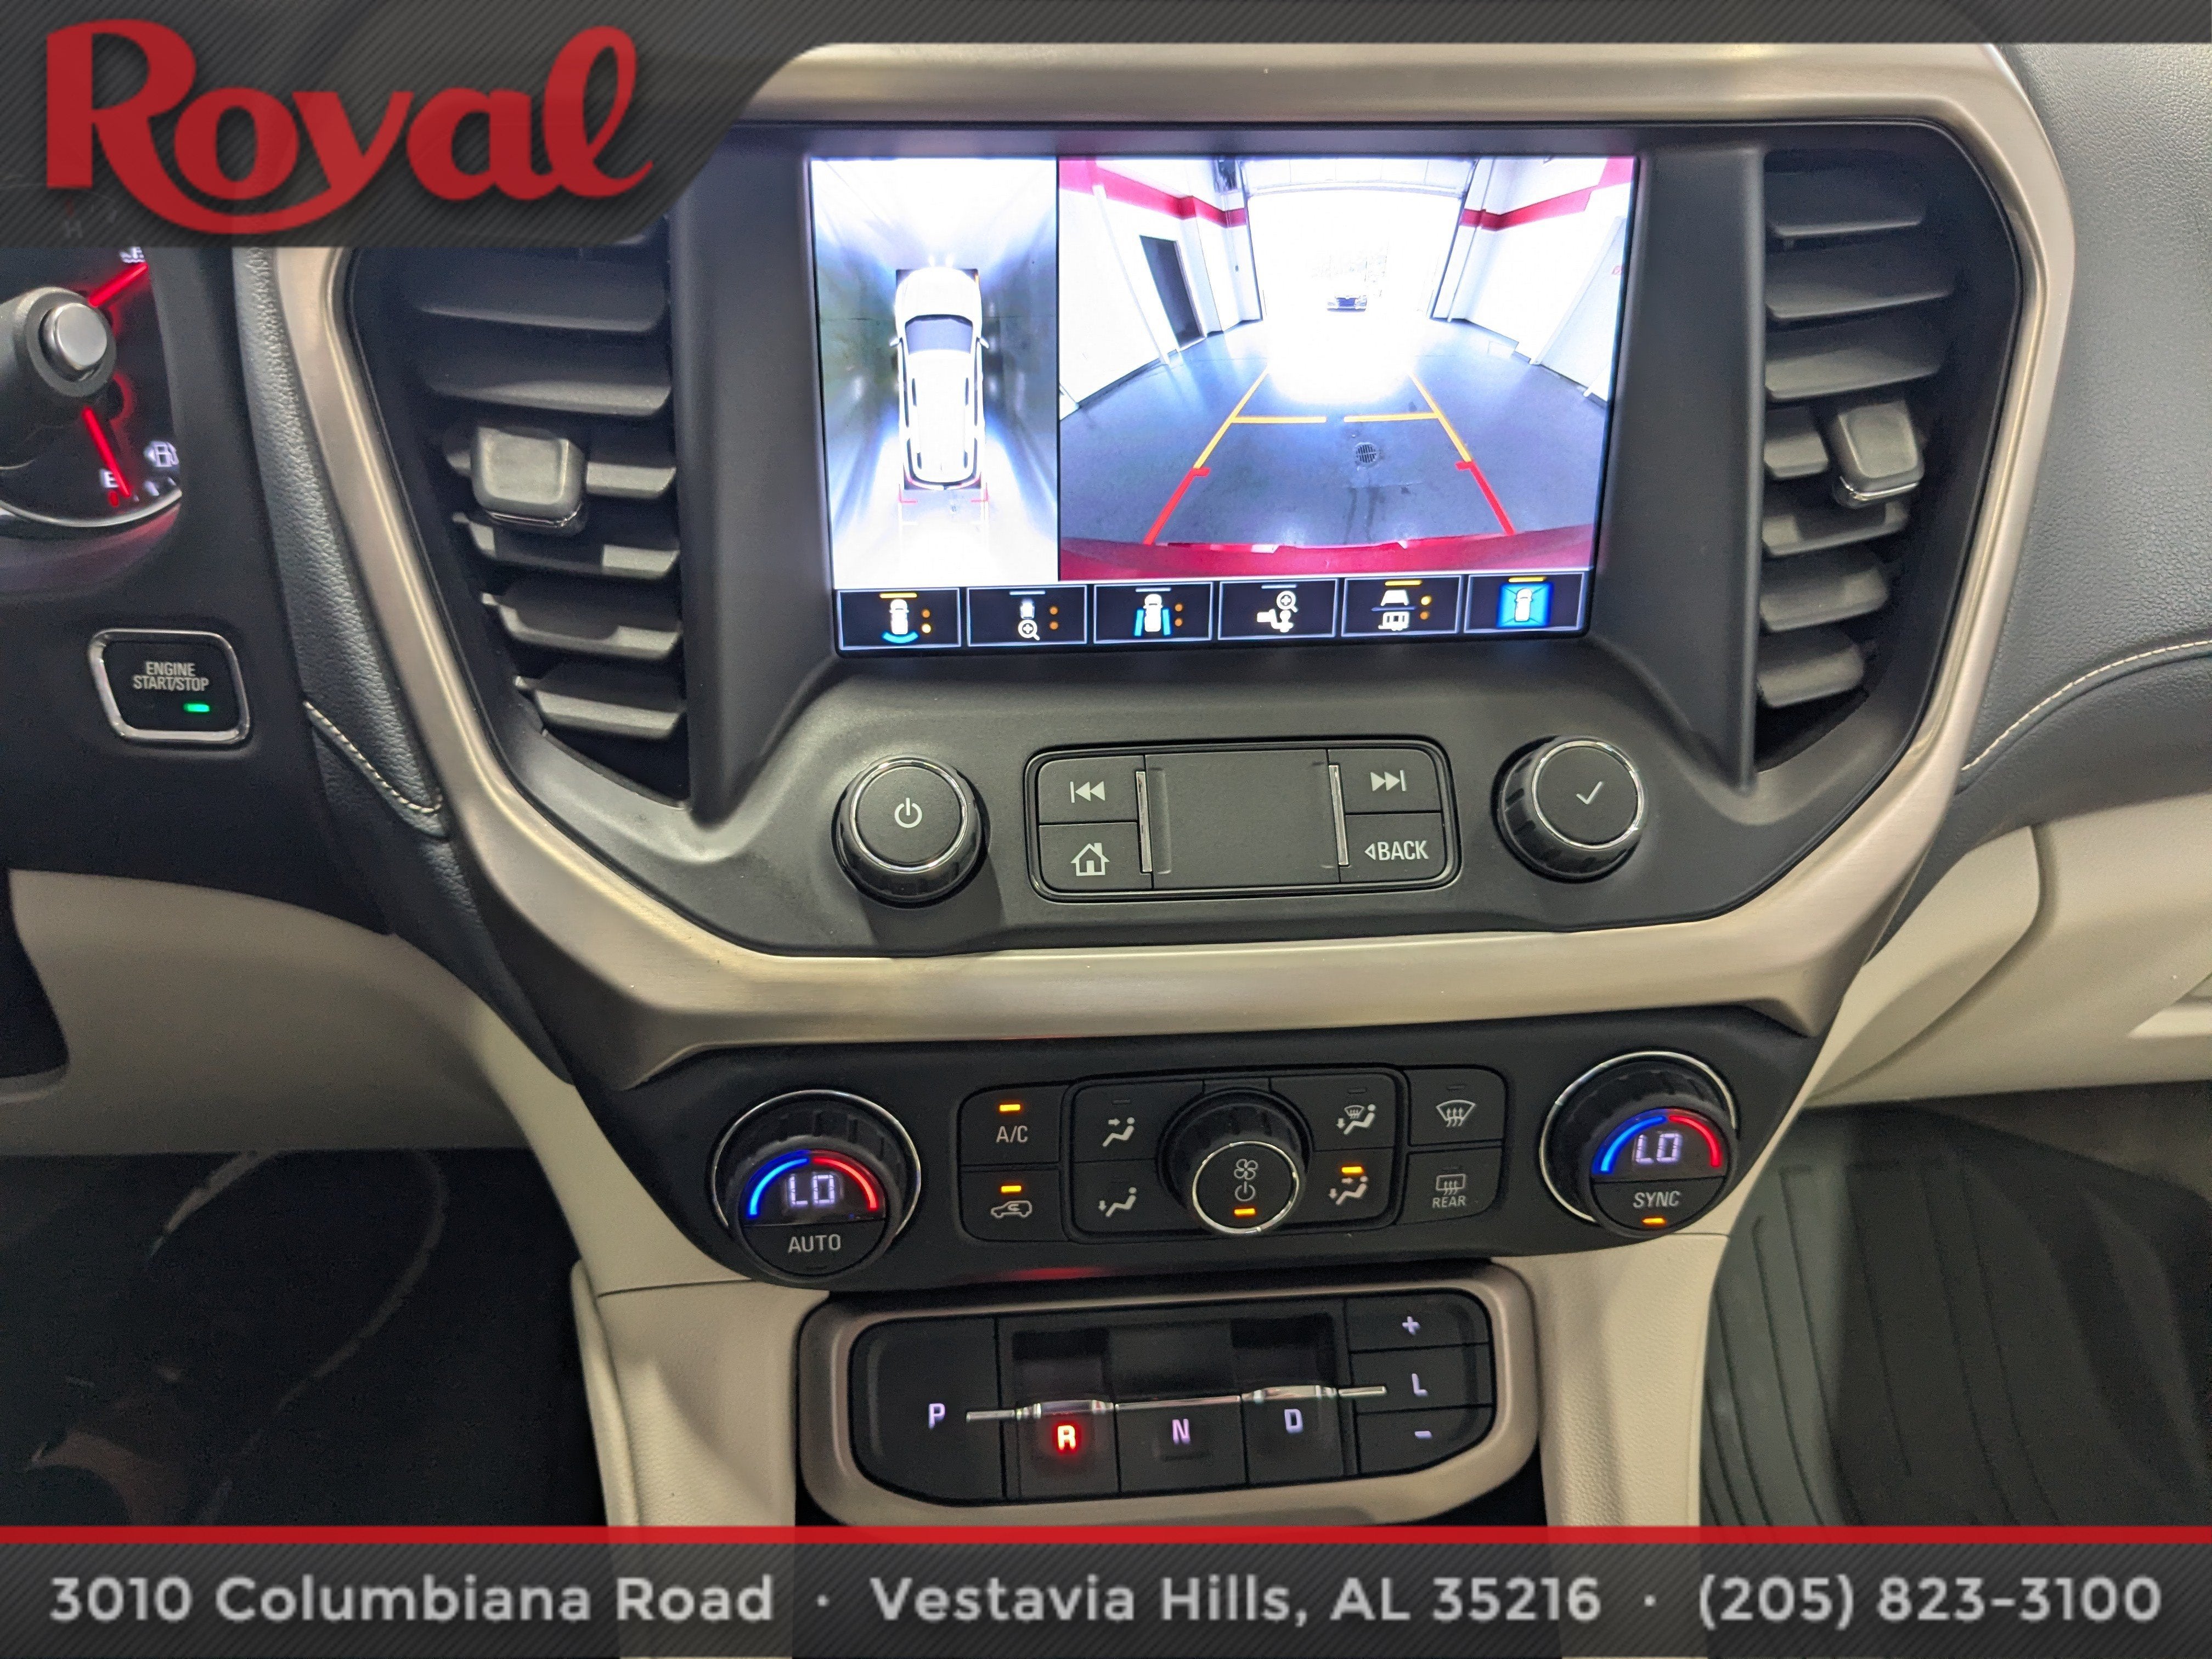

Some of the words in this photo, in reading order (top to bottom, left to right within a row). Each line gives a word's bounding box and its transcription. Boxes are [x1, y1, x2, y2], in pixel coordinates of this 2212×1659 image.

[144, 661, 196, 677] ENGINE
[132, 674, 210, 691] START/STOP
[1376, 840, 1430, 861] BACK
[995, 1125, 1029, 1143] A/C
[1635, 1132, 1682, 1164] LO
[789, 1173, 836, 1206] LO
[1632, 1190, 1681, 1209] SYNC
[1432, 1195, 1466, 1208] REAR
[788, 1233, 842, 1254] AUTO
[1412, 1373, 1428, 1397] L
[928, 1403, 946, 1429] P
[1284, 1408, 1304, 1434] D
[1057, 1424, 1077, 1451] R
[1172, 1418, 1190, 1444] N
